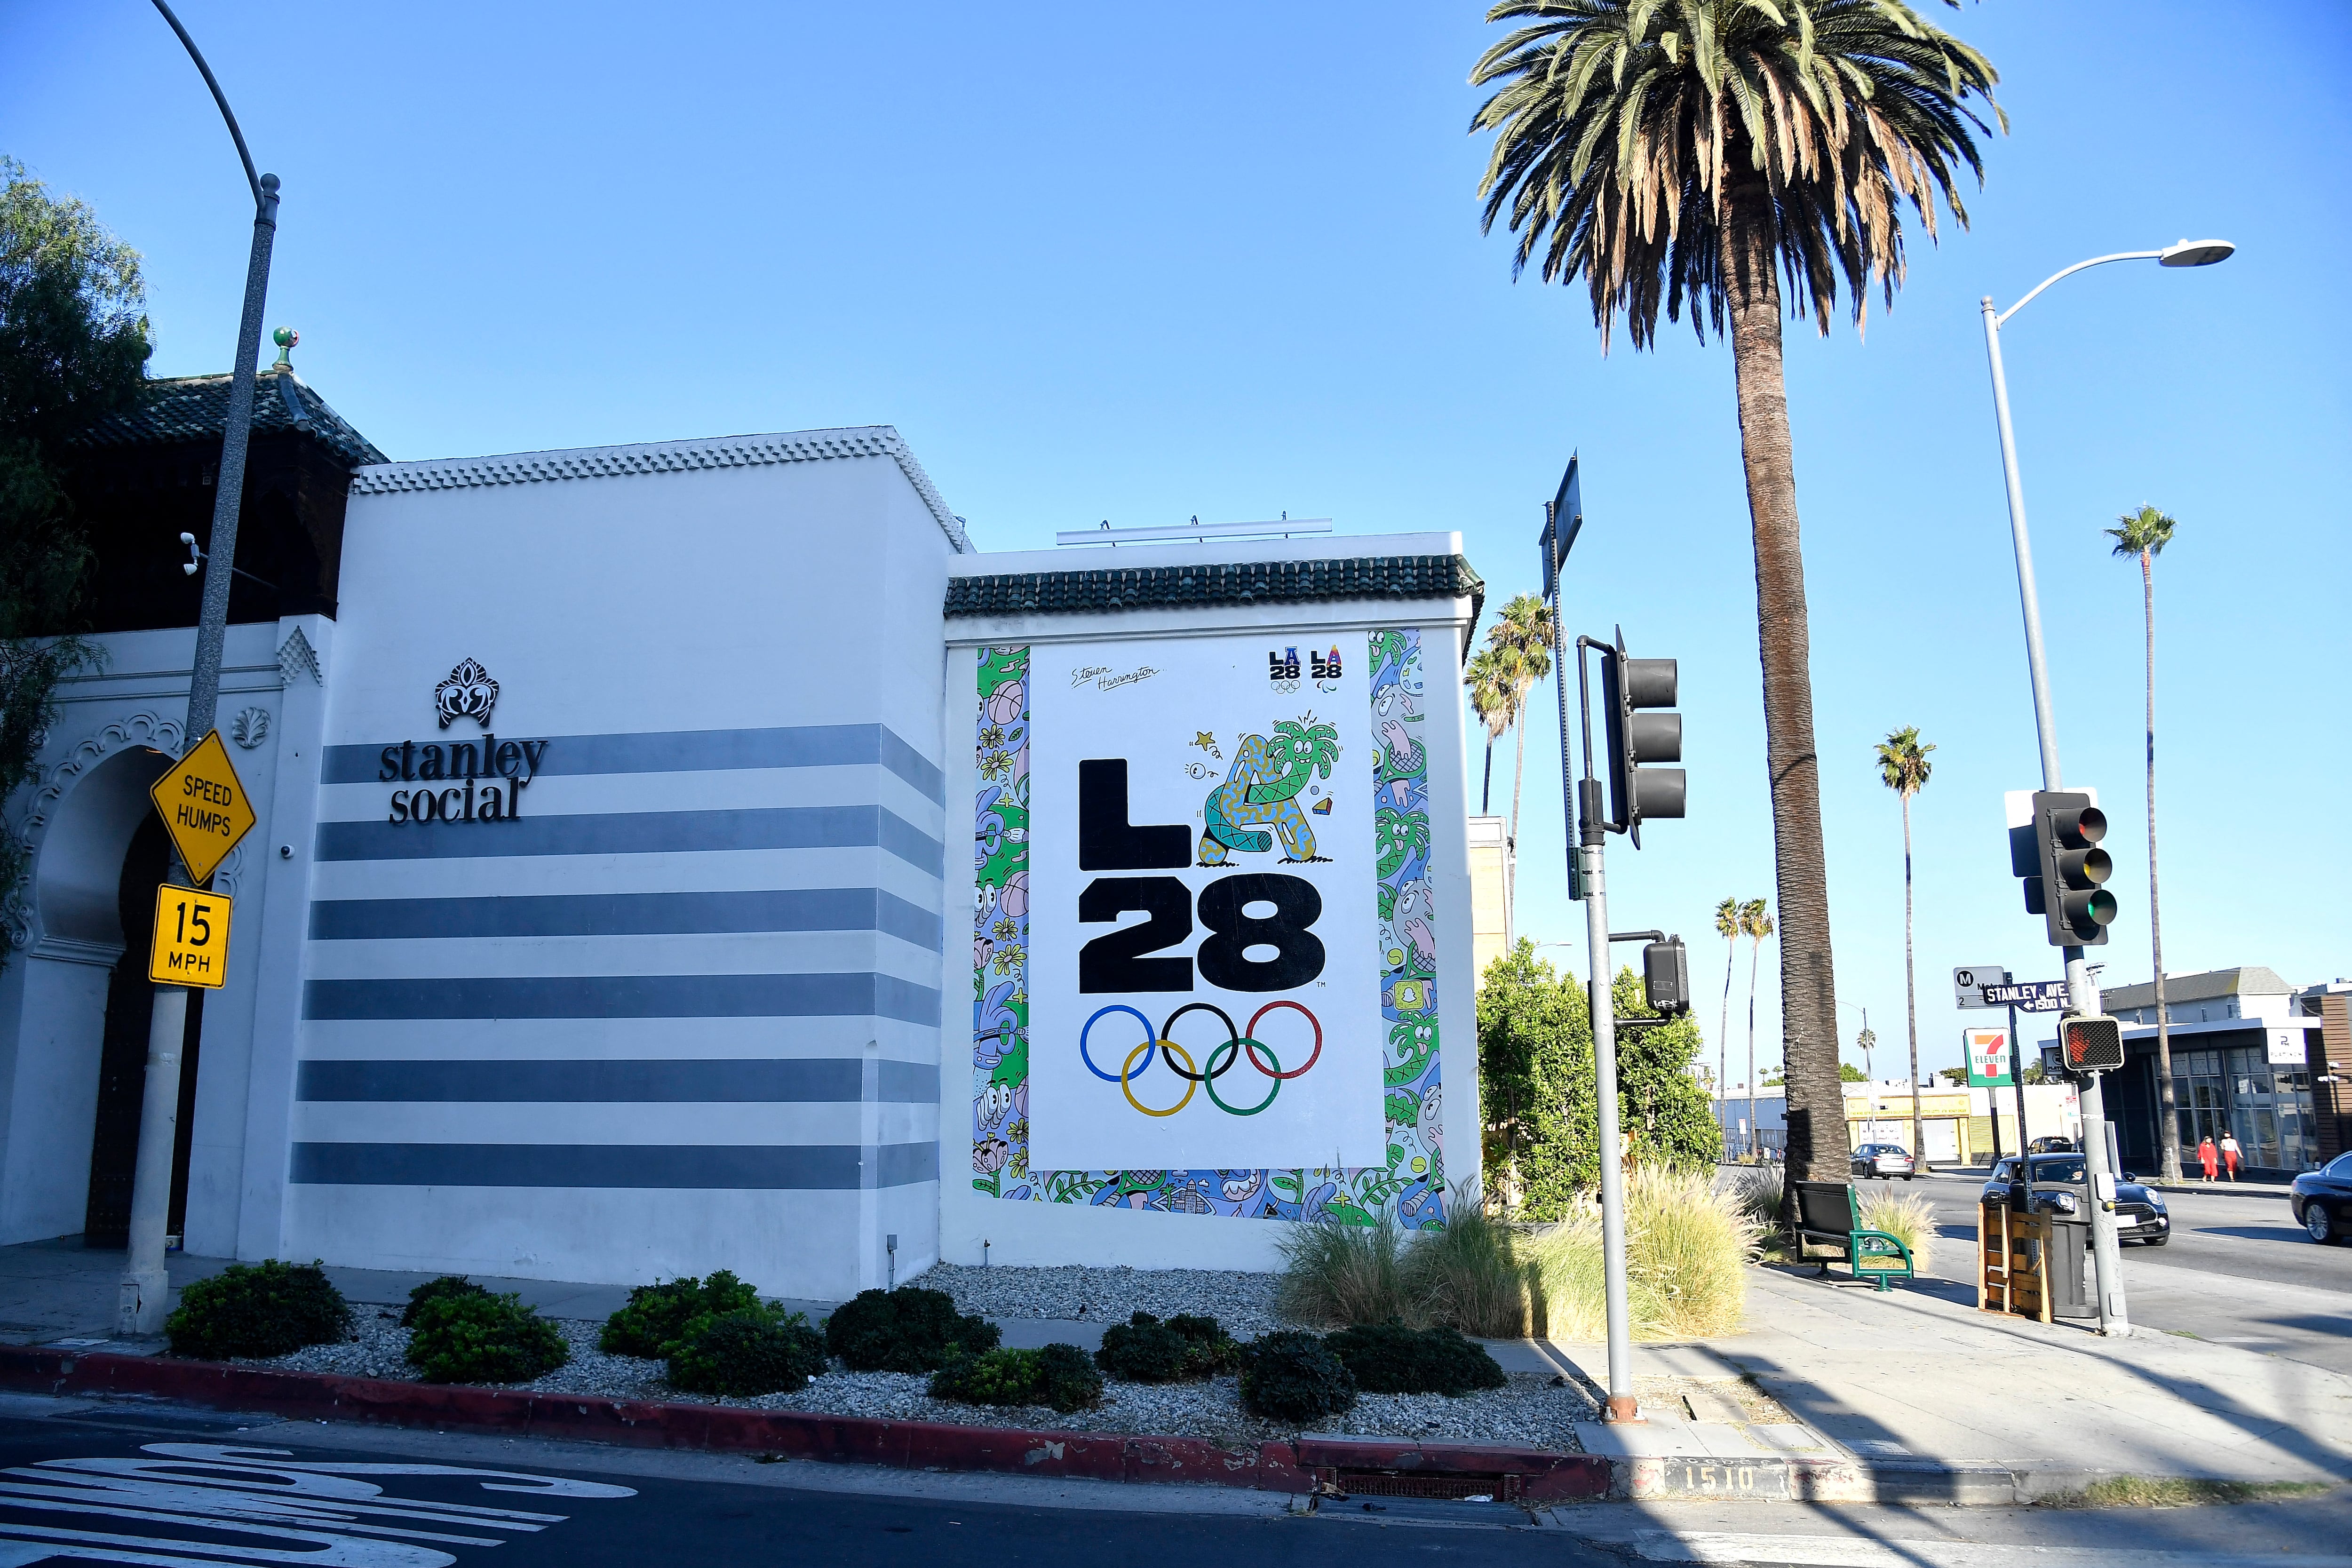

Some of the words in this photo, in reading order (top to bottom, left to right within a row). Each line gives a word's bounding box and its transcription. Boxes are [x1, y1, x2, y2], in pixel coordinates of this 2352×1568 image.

[1270, 646, 1301, 666] LA
[1311, 645, 1341, 667] LA
[1072, 666, 1112, 685] Steven
[1097, 666, 1160, 690] Harrington
[1271, 665, 1300, 680] 28
[1311, 664, 1342, 678] 28
[379, 733, 548, 788] stanley
[183, 774, 232, 807] SPEED
[389, 778, 521, 824] social
[176, 803, 231, 837] HUMPS
[176, 902, 210, 947] 15
[1079, 873, 1326, 994] 28
[168, 951, 211, 973] MPH
[1958, 997, 1965, 1006] 2
[1986, 985, 2037, 1002] STANLEY
[2047, 983, 2069, 998] AVE.
[2034, 998, 2058, 1010] 1500
[1685, 1465, 1754, 1490] 1510
